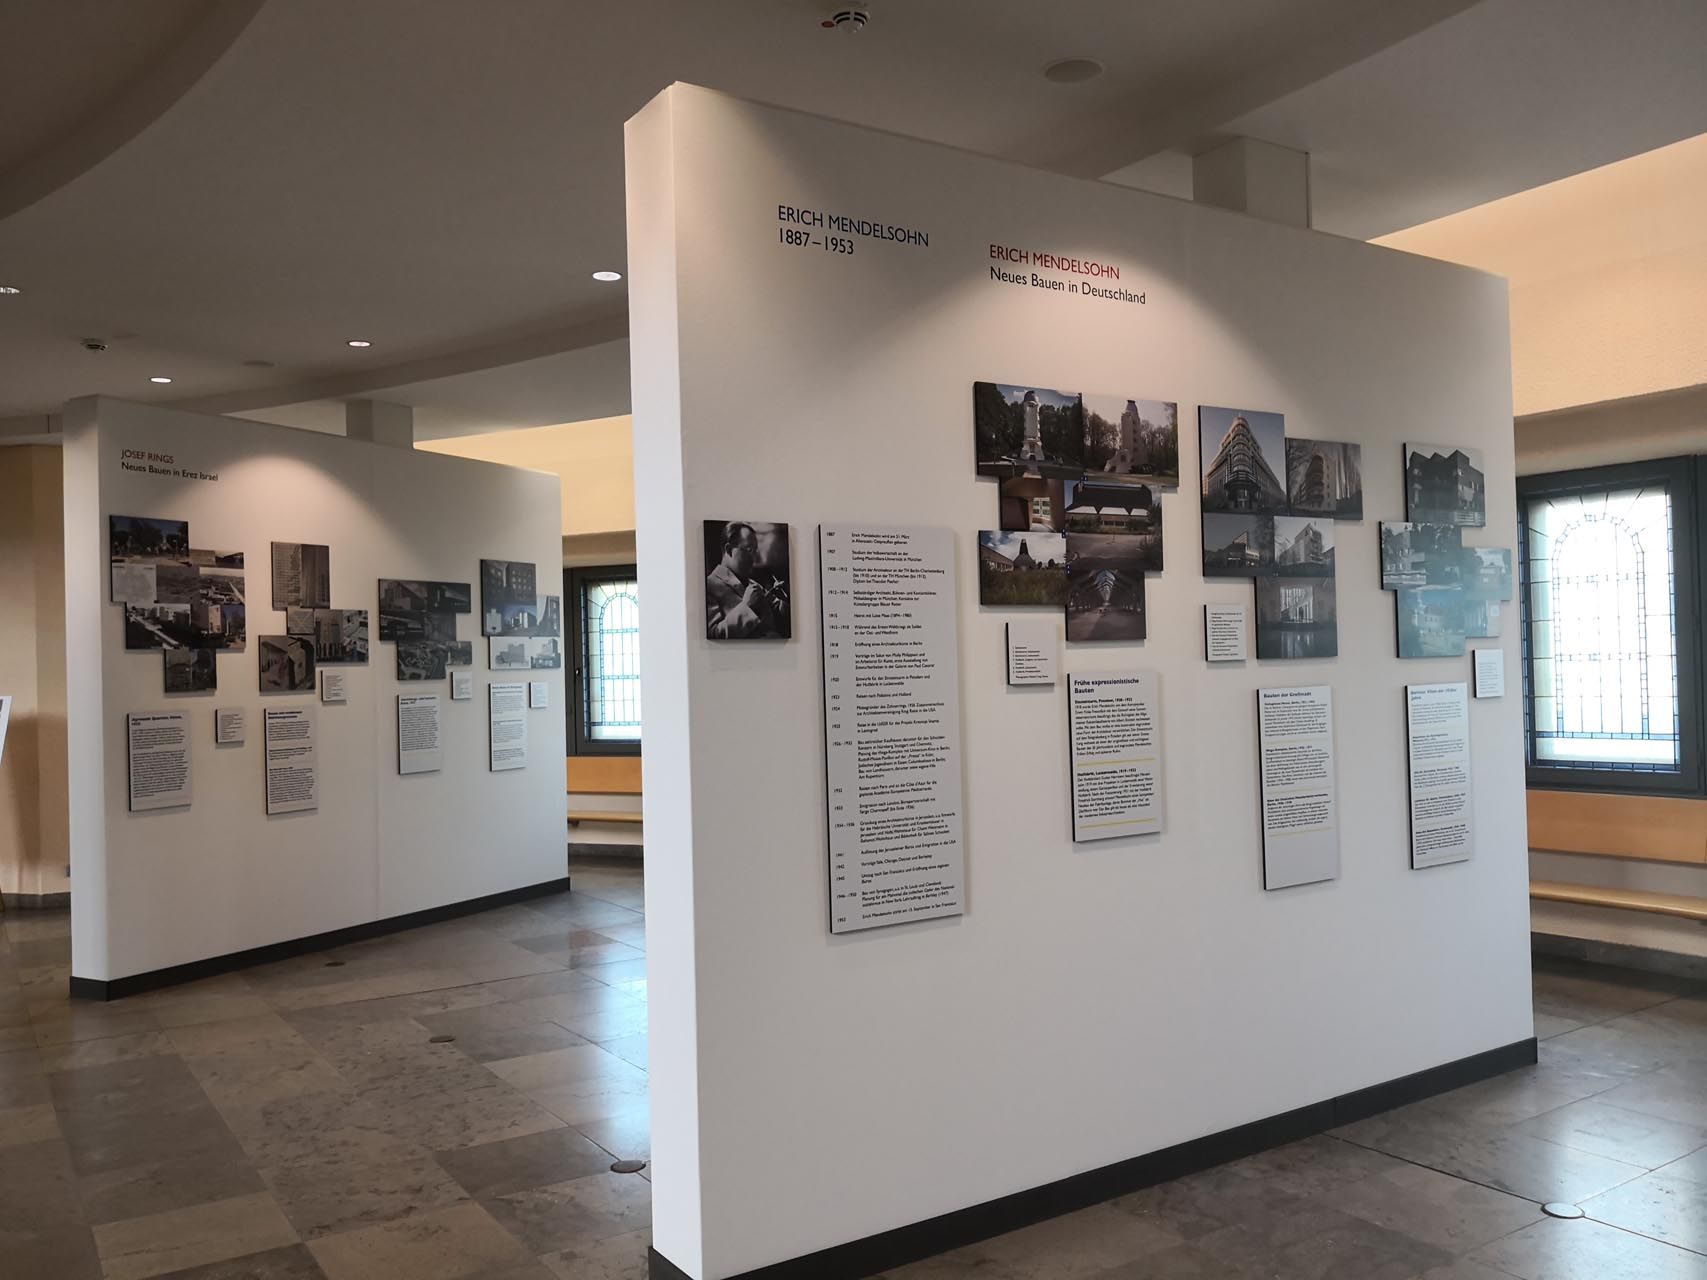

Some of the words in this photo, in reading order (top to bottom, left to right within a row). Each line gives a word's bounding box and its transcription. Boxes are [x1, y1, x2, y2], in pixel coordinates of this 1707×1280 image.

[778, 205, 824, 228] ERICH
[828, 214, 929, 247] MENDELSOHN
[990, 244, 1029, 265] ERICH
[1033, 252, 1120, 280] MENDELSOHN
[990, 266, 1028, 286] Neues
[1031, 273, 1065, 292] Bauen
[1068, 280, 1078, 293] in
[1082, 281, 1146, 305] Deutschland
[121, 449, 146, 460] JOSEF
[148, 452, 175, 464] RINGS
[121, 461, 147, 472] Neues
[148, 465, 171, 476] Bauen
[173, 468, 180, 477] in
[200, 471, 219, 481] Israel
[1091, 678, 1139, 686] expressionistische
